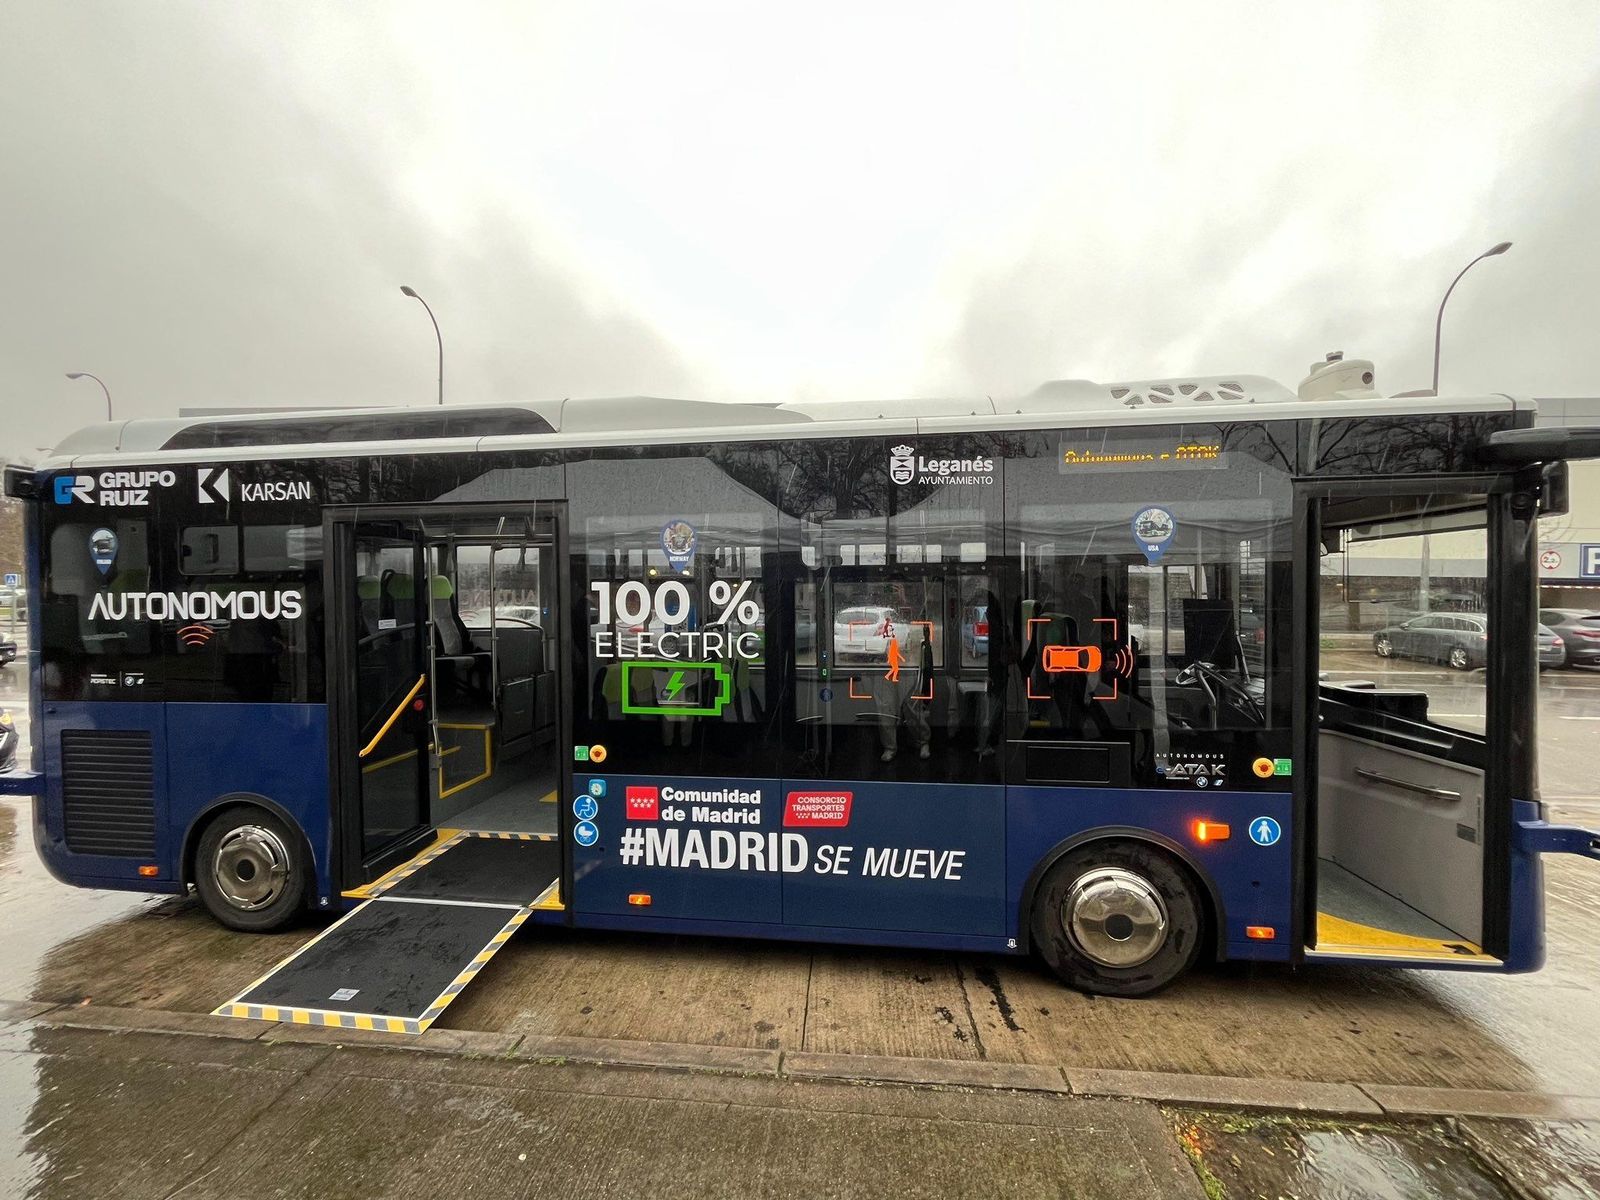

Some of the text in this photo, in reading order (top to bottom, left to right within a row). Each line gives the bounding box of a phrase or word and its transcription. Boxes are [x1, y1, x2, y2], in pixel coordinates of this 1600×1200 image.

[918, 455, 994, 475] Leganés
[99, 471, 176, 488] GRUPO
[918, 475, 994, 486] AYUNTAMIENTO
[99, 490, 149, 507] RUIZ
[241, 481, 311, 502] KARSAN
[88, 590, 302, 621] AUTONOMOUS
[590, 580, 760, 626] 100 %
[595, 631, 762, 660] ELECTRIC
[661, 787, 761, 805] Comunidad
[797, 796, 847, 804] CONSORCIO
[661, 806, 761, 825] de Madrid
[792, 804, 845, 812] TRANSPORTES
[811, 812, 844, 820] MADRID
[620, 828, 967, 881] #MADRID SE MUEVE
